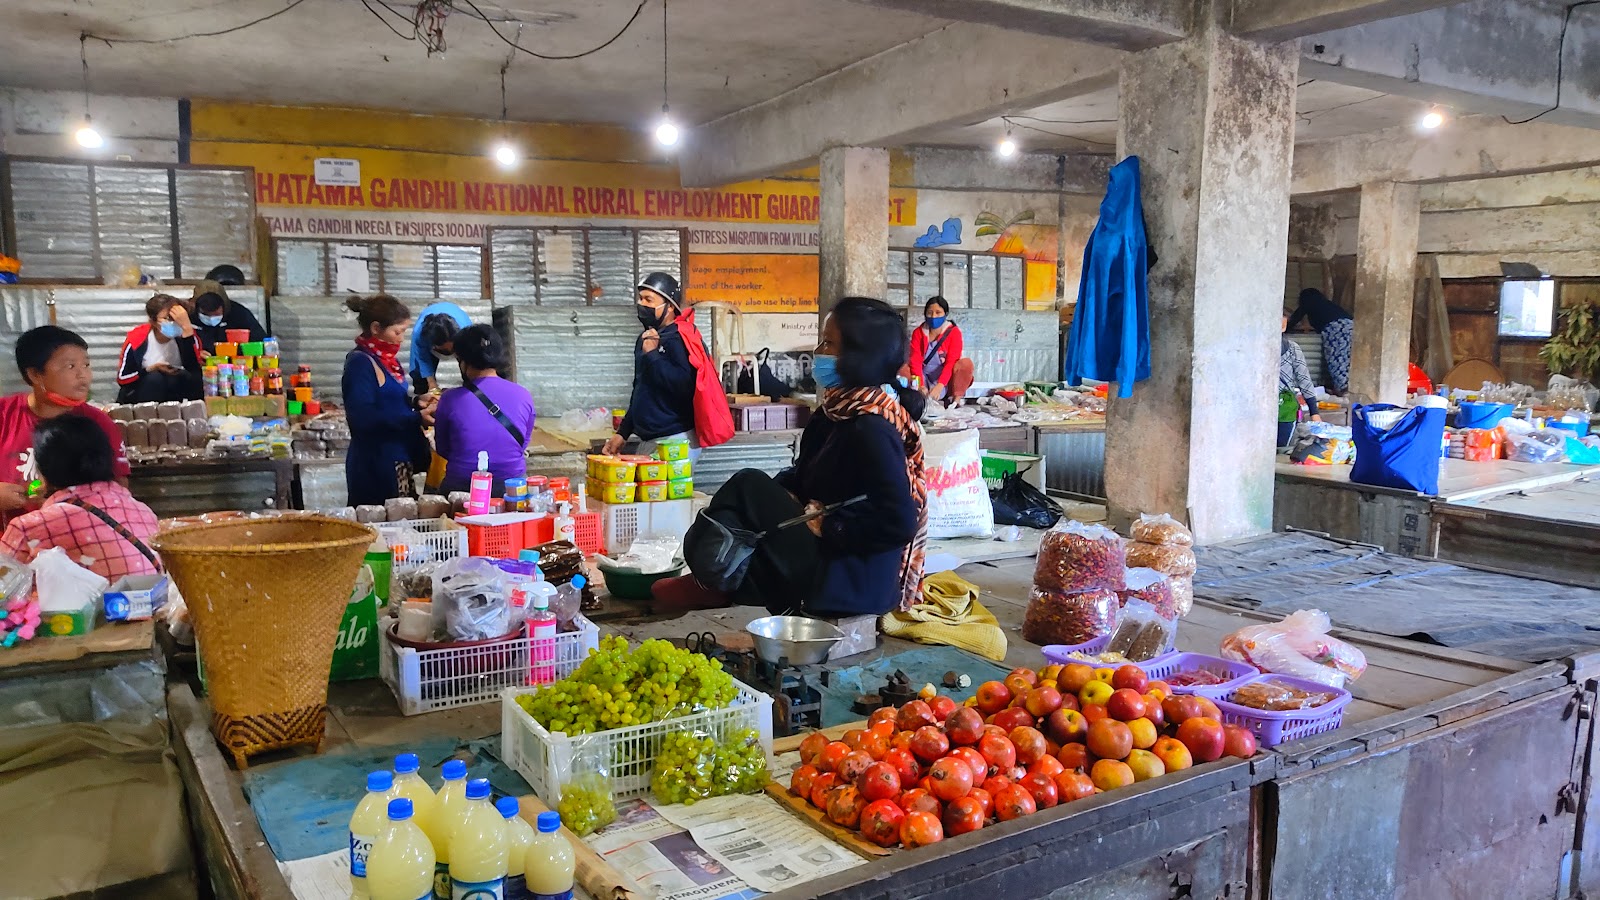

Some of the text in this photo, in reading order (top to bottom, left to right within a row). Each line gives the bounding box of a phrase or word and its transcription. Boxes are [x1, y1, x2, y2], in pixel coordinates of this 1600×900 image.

[370, 177, 457, 209] GANDHI
[464, 181, 570, 214] NATIONAL
[573, 186, 640, 216] RURAL
[644, 189, 763, 219] EMPLOYMENT
[767, 194, 820, 221] GUARA
[307, 218, 352, 235] GANDHI
[355, 219, 393, 236] NREGA
[395, 221, 445, 237] ENSURES
[446, 223, 464, 238] 100
[466, 223, 487, 239] DAY
[728, 231, 769, 246] MIGRATION
[770, 231, 791, 247] FROM
[692, 266, 712, 274] wage
[710, 281, 720, 290] of
[721, 281, 734, 290] the
[745, 297, 762, 306] also
[780, 297, 797, 308] help
[798, 297, 813, 306] line
[781, 322, 807, 331] Ministry
